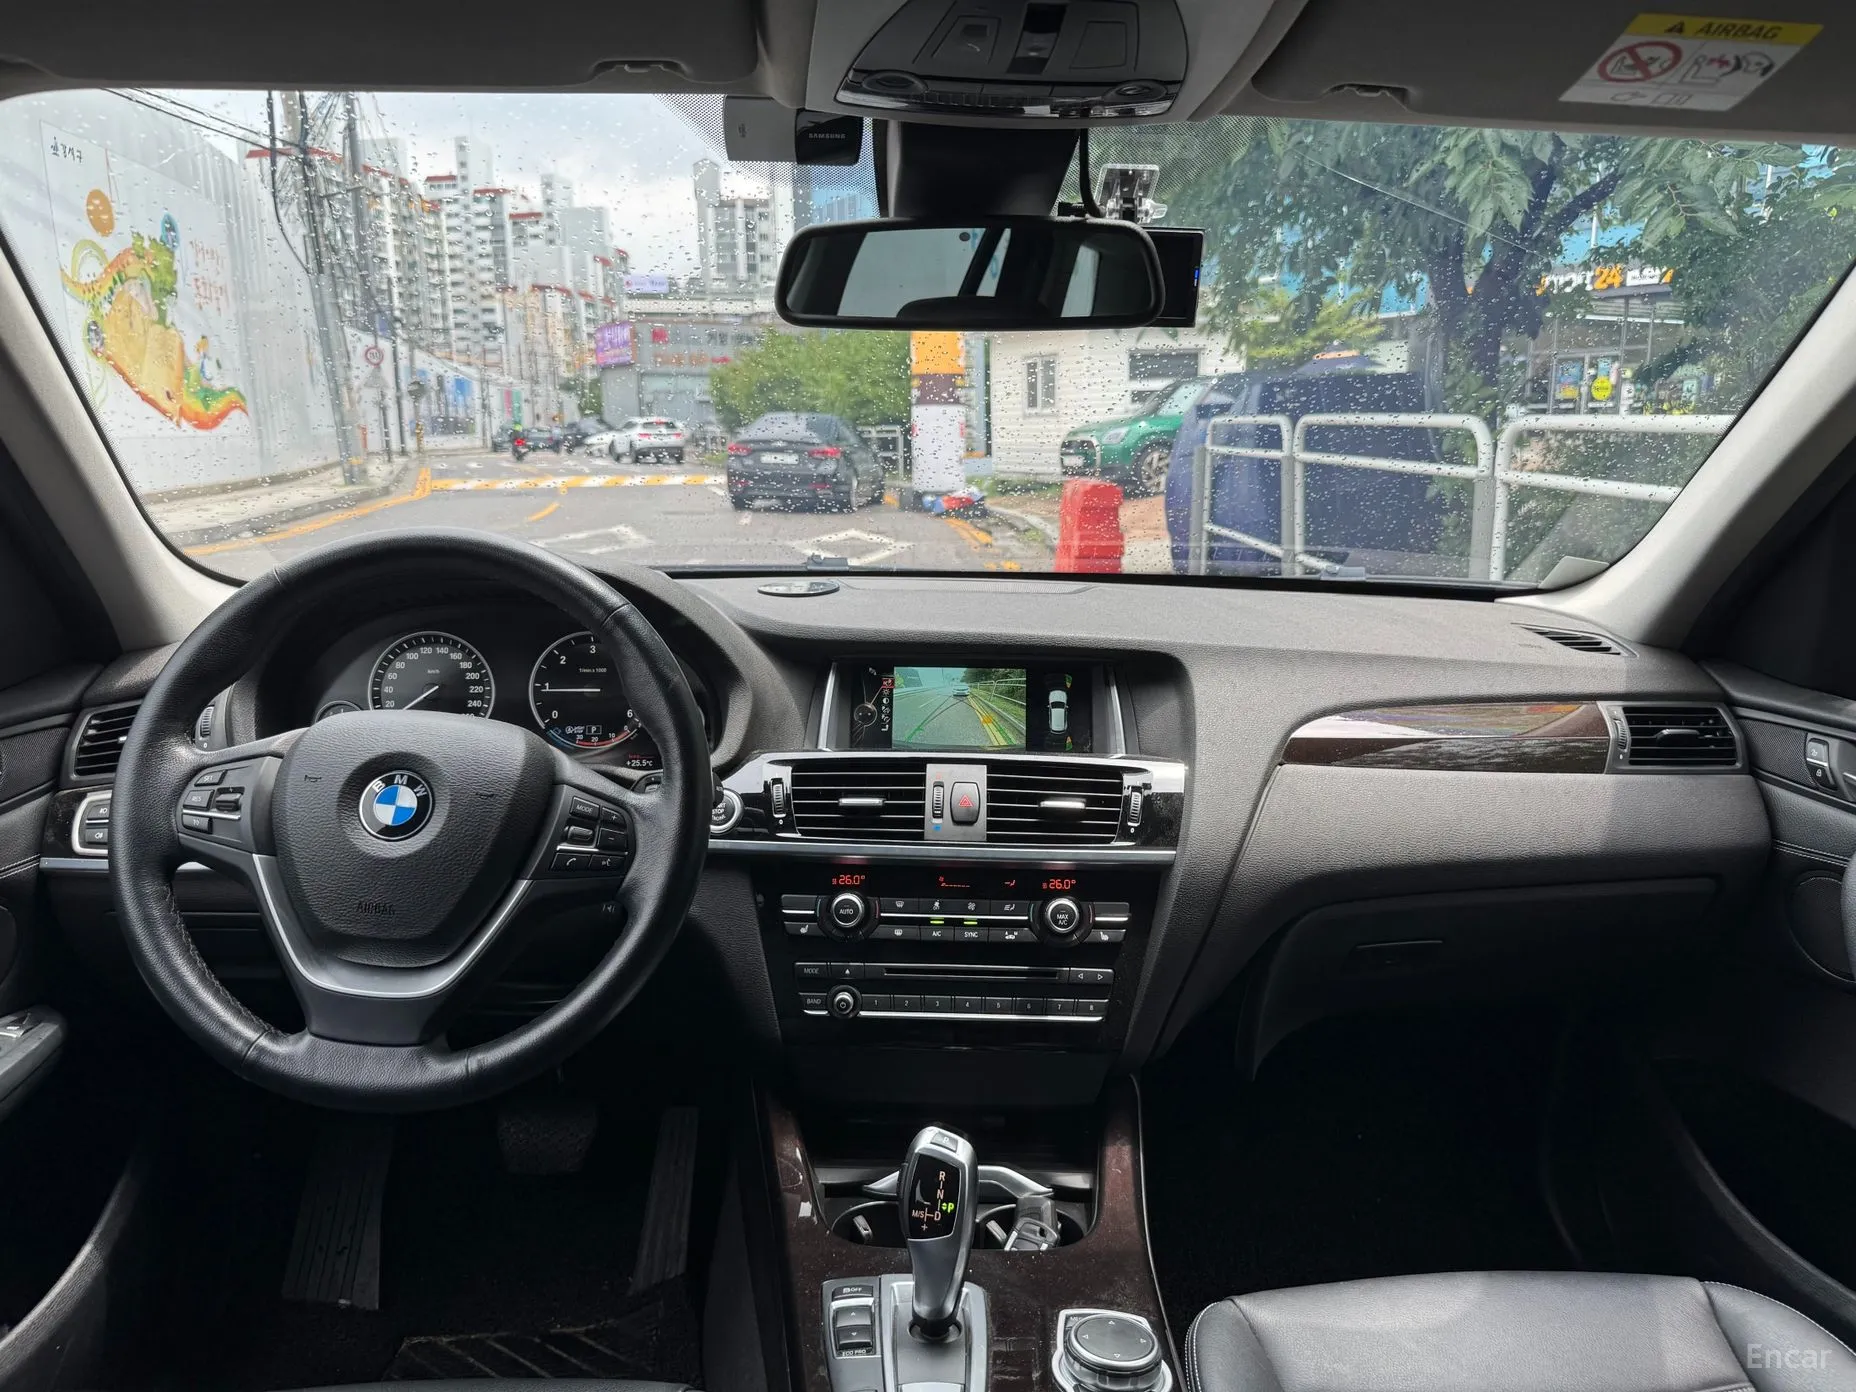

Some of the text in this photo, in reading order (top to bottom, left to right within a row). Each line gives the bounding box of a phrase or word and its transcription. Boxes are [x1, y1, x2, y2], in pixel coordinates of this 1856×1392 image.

[1695, 21, 1783, 39] AIRBAG
[590, 646, 596, 654] 3
[560, 656, 566, 664] 2
[544, 682, 550, 690] 1
[552, 710, 558, 718] 0
[627, 710, 633, 718] 6
[372, 774, 428, 798] BMW
[576, 804, 592, 814] MODE
[939, 1171, 946, 1181] R
[937, 1189, 944, 1200] N
[948, 1202, 954, 1213] P
[912, 1210, 924, 1218] M/S
[934, 1211, 941, 1221] D
